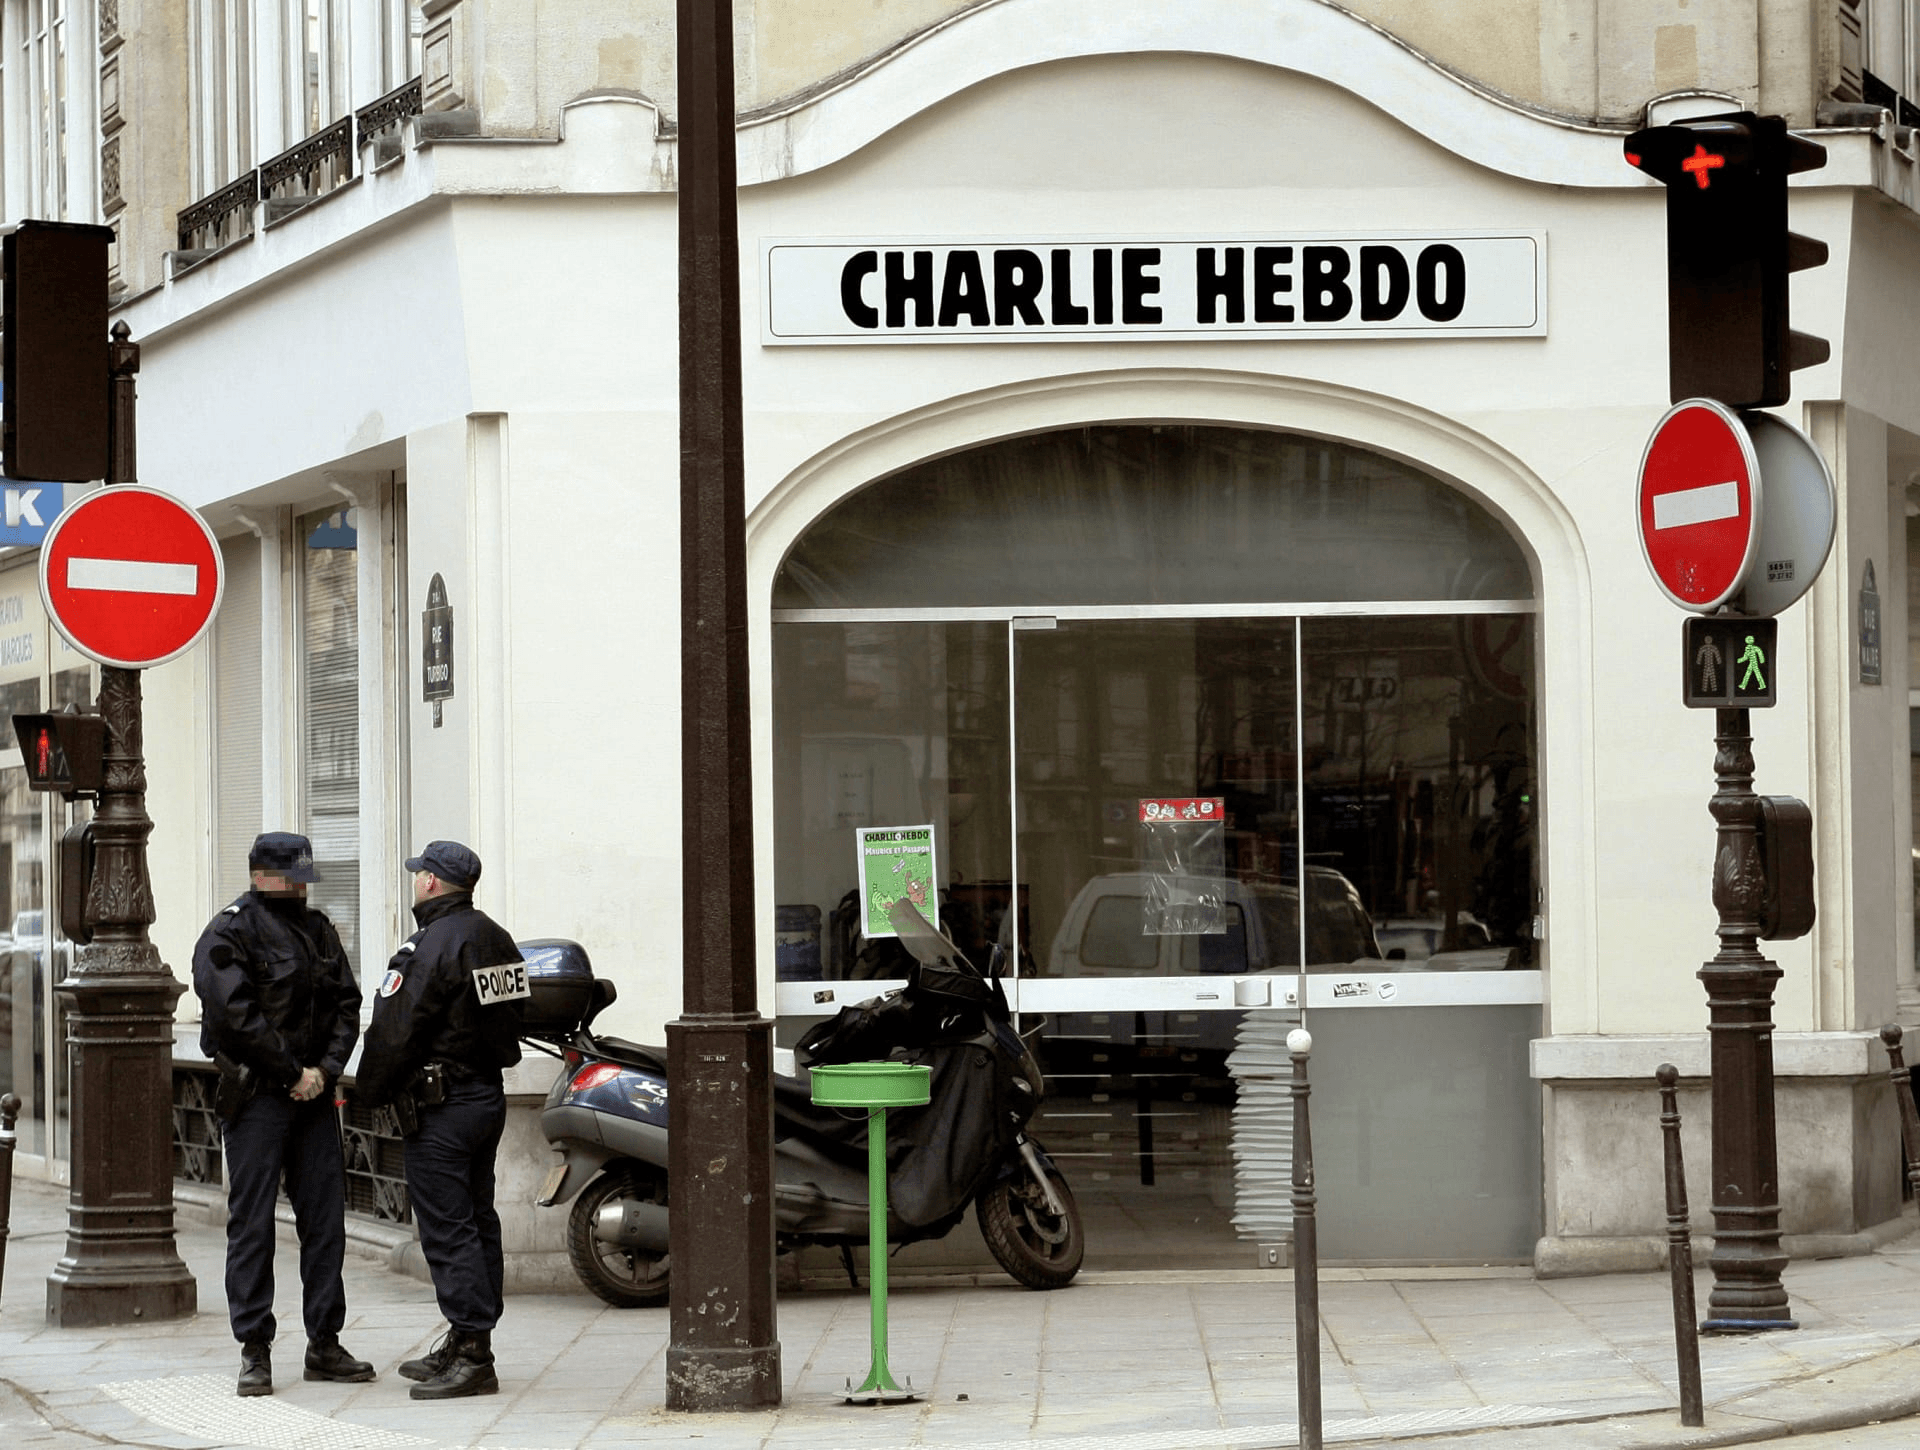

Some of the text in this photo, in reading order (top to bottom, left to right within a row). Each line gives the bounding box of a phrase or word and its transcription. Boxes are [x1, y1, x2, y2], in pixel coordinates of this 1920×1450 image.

[840, 243, 1466, 328] CHARLIE HEBDO
[0, 488, 45, 527] K
[431, 625, 442, 644] RUE
[427, 663, 449, 684] TURBIGO
[900, 830, 929, 841] HEBDO
[478, 967, 525, 999] POLICE
